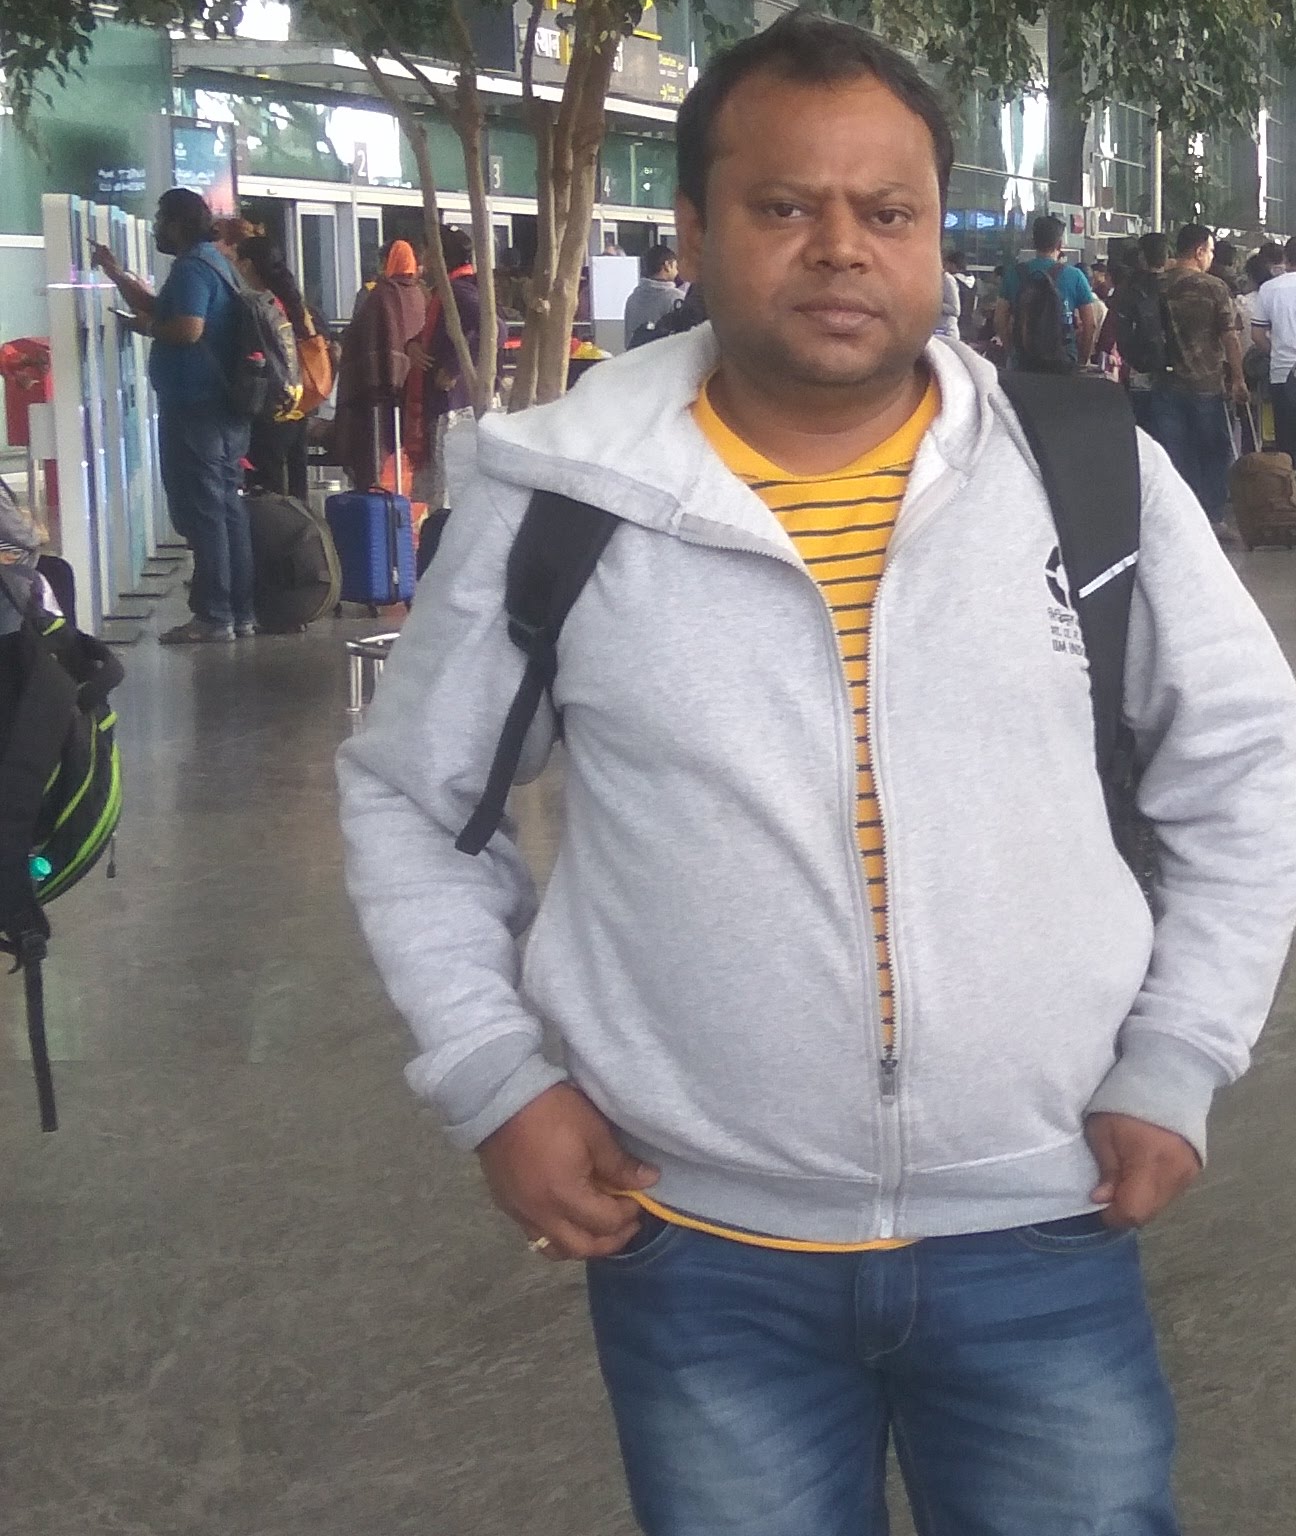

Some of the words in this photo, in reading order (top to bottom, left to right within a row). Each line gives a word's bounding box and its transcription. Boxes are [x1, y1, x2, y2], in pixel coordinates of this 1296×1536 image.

[357, 149, 367, 177] 2
[492, 163, 500, 189] 3
[603, 175, 611, 197] 4
